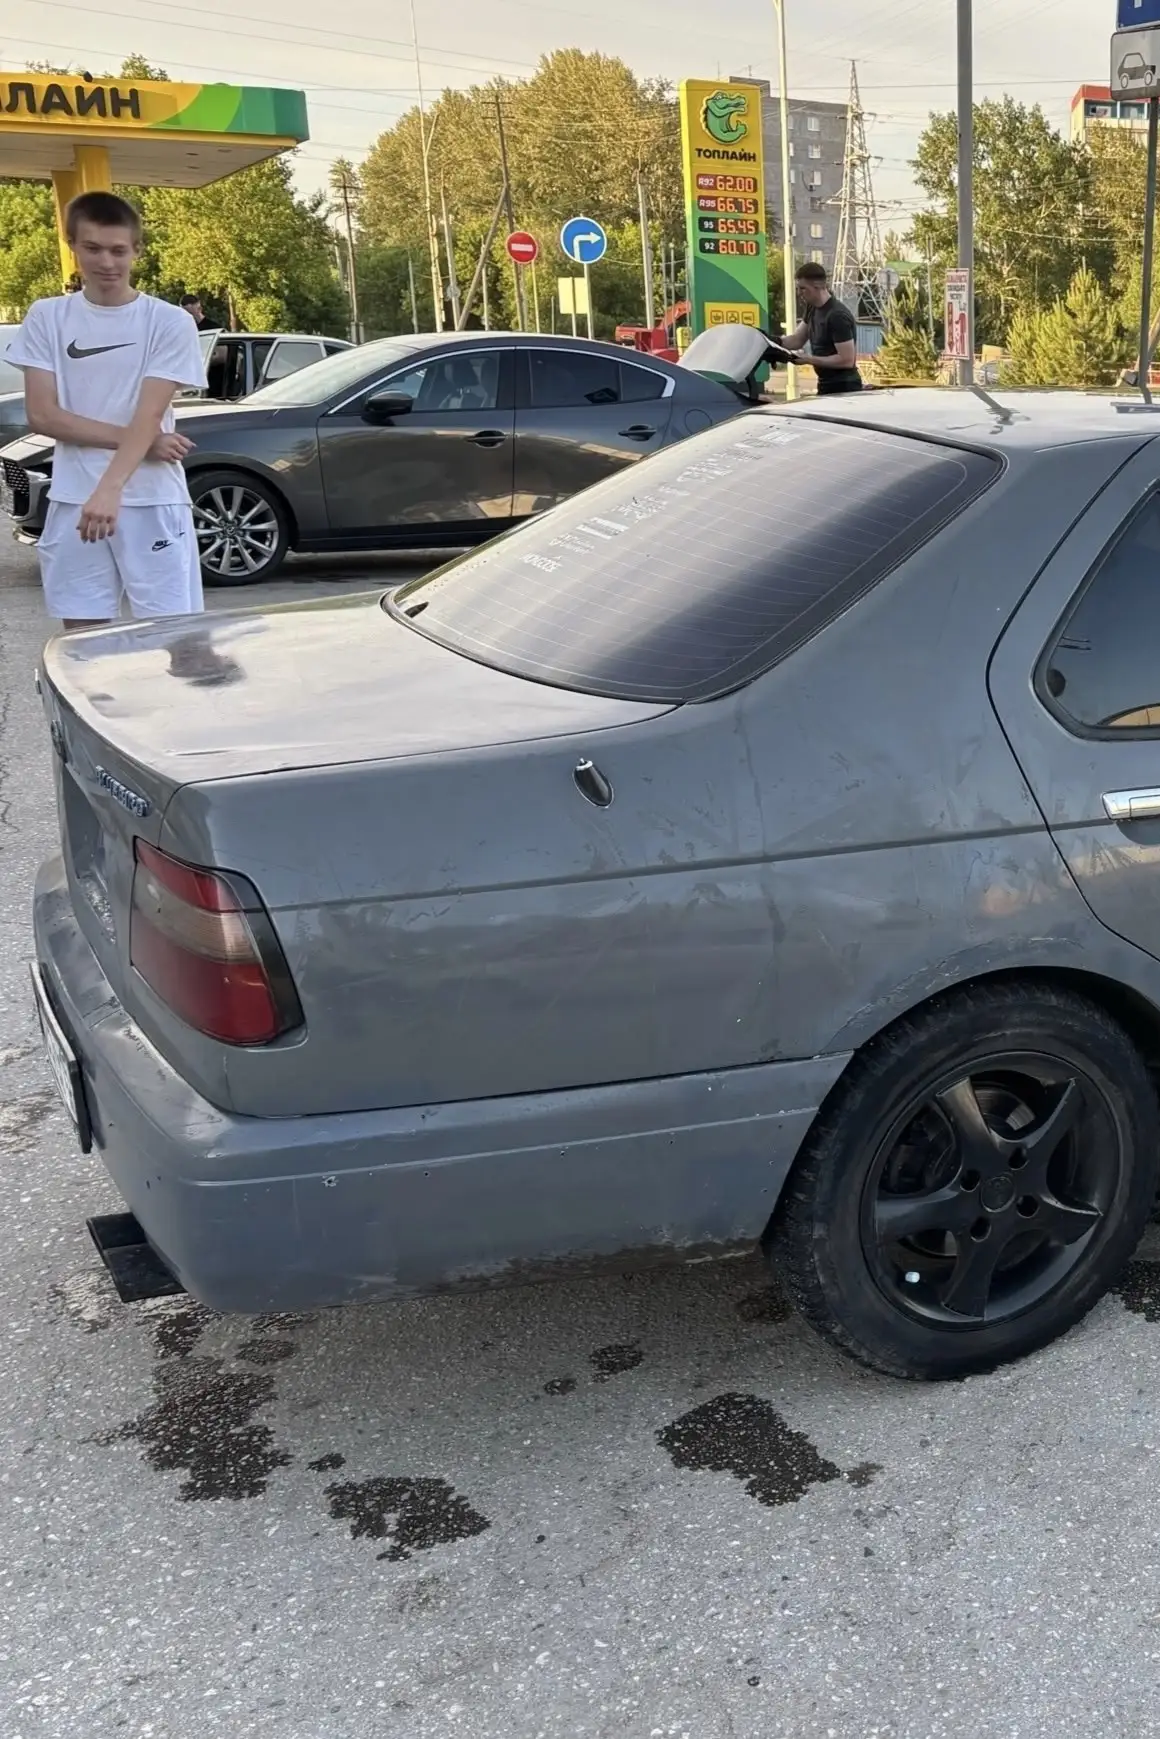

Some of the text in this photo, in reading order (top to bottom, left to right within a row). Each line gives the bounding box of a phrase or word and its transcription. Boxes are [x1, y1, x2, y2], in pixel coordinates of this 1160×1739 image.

[0, 71, 141, 119] ЛАЙН
[695, 148, 757, 162] ТОПЛАЙН
[716, 175, 754, 193] 62.00
[717, 197, 755, 214] 66.75
[704, 218, 756, 234] 95 65.45
[704, 239, 756, 255] 92 60.70
